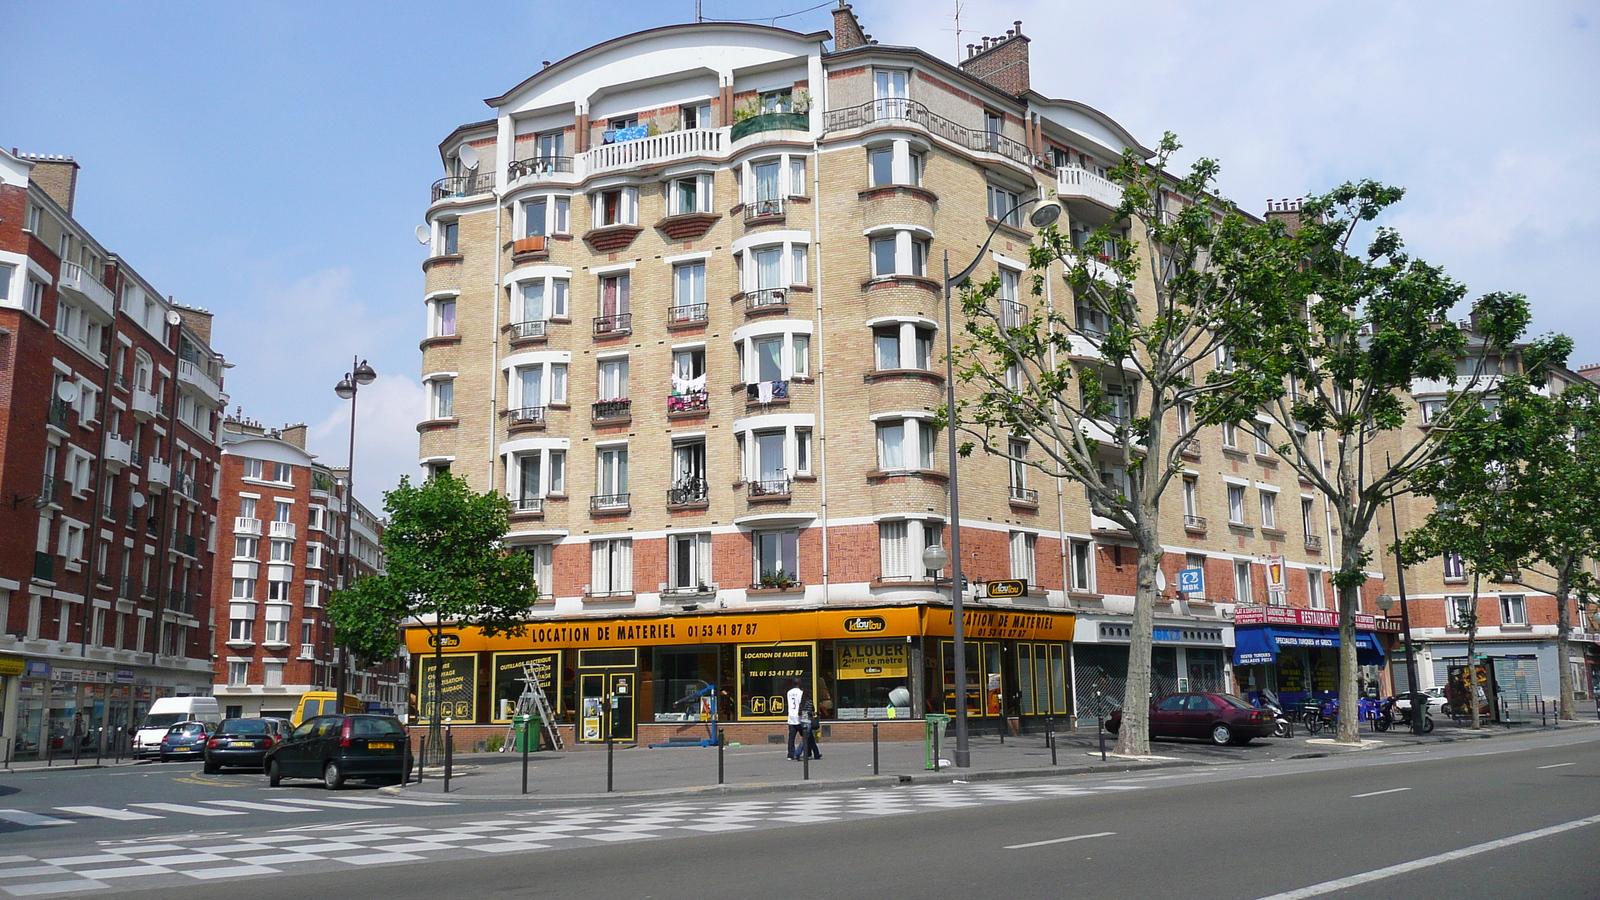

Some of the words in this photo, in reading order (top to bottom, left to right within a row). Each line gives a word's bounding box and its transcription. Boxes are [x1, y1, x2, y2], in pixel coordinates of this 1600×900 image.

[948, 611, 994, 627] LCATION
[998, 615, 1008, 627] DE
[1012, 615, 1053, 629] MATERIEL
[1301, 610, 1333, 626] RESTAURANT
[532, 627, 590, 643] LOCATION
[597, 627, 610, 641] DE
[617, 623, 676, 641] MATERIEL
[687, 625, 699, 637] 01
[702, 625, 713, 637] 53
[716, 624, 727, 636] 41
[731, 624, 743, 636] 87
[745, 623, 758, 635] 87
[977, 629, 986, 637] 01
[988, 629, 997, 637] 53
[1007, 630, 1017, 638] 87
[1018, 630, 1027, 638] 87
[856, 643, 904, 657] LOUER
[867, 657, 875, 665] le
[877, 656, 903, 664] mètre
[791, 697, 797, 710] 3
